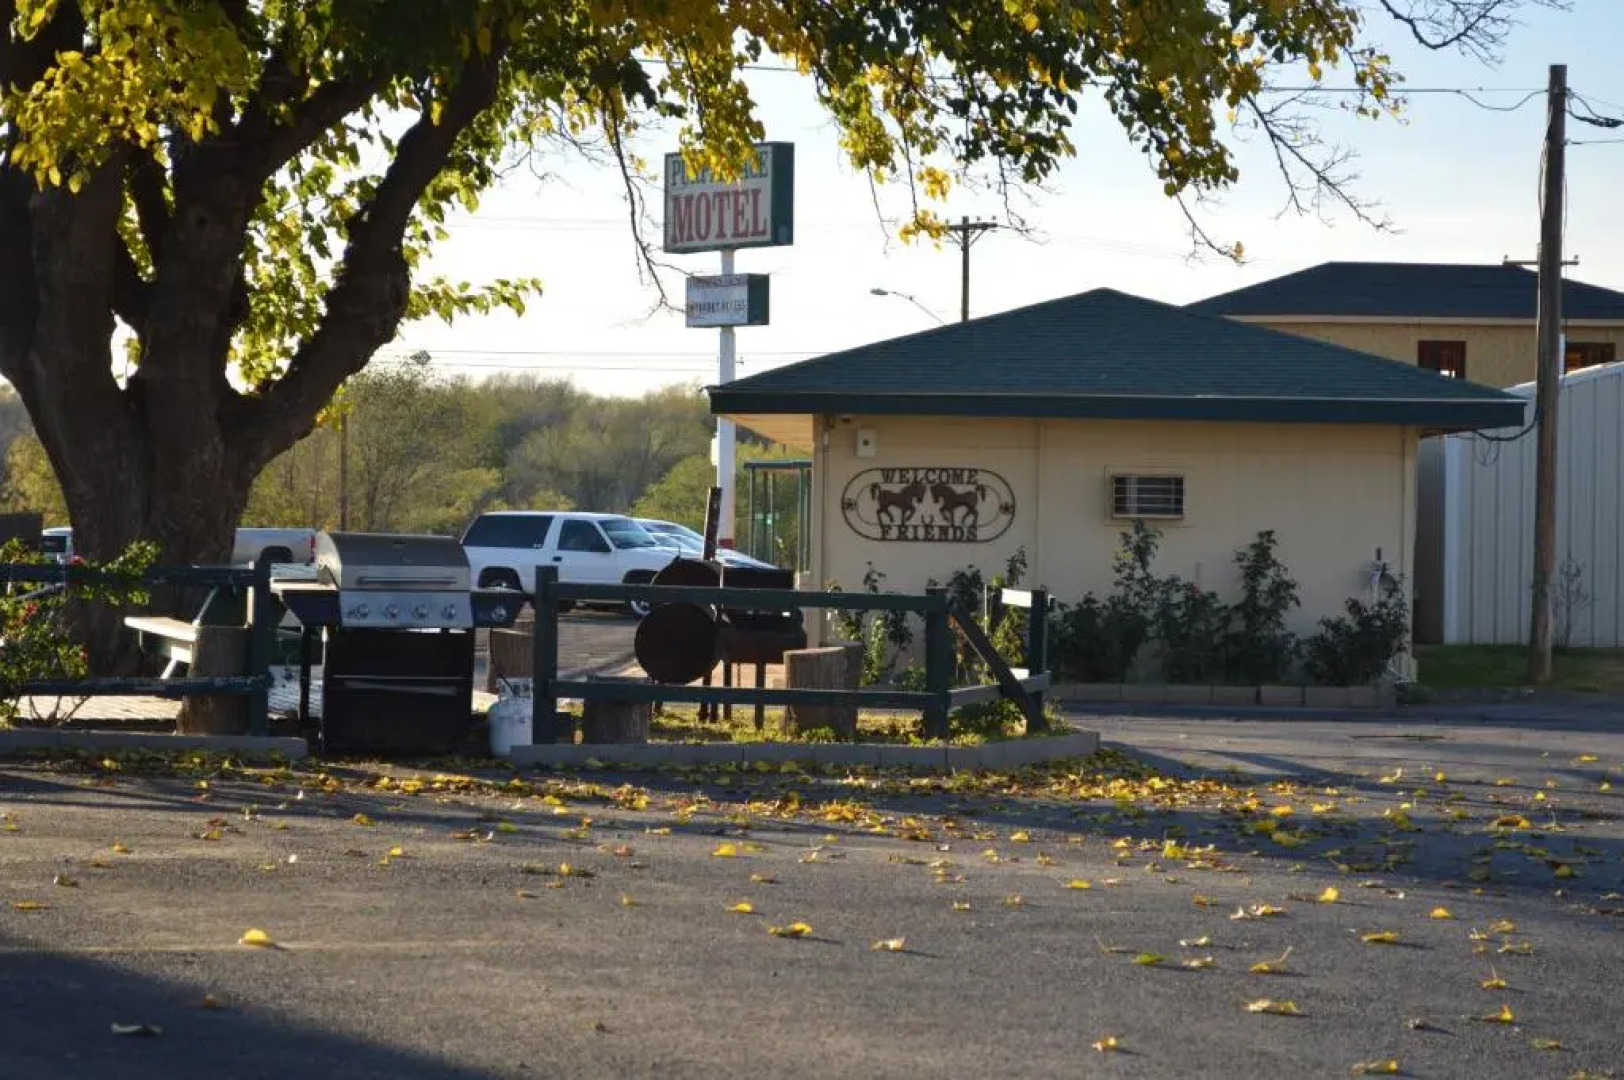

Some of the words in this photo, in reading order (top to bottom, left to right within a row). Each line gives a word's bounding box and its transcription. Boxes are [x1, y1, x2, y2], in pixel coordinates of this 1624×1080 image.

[671, 188, 767, 244] MOTEL
[881, 468, 978, 485] WELCOME
[881, 525, 978, 541] FRIENDS
